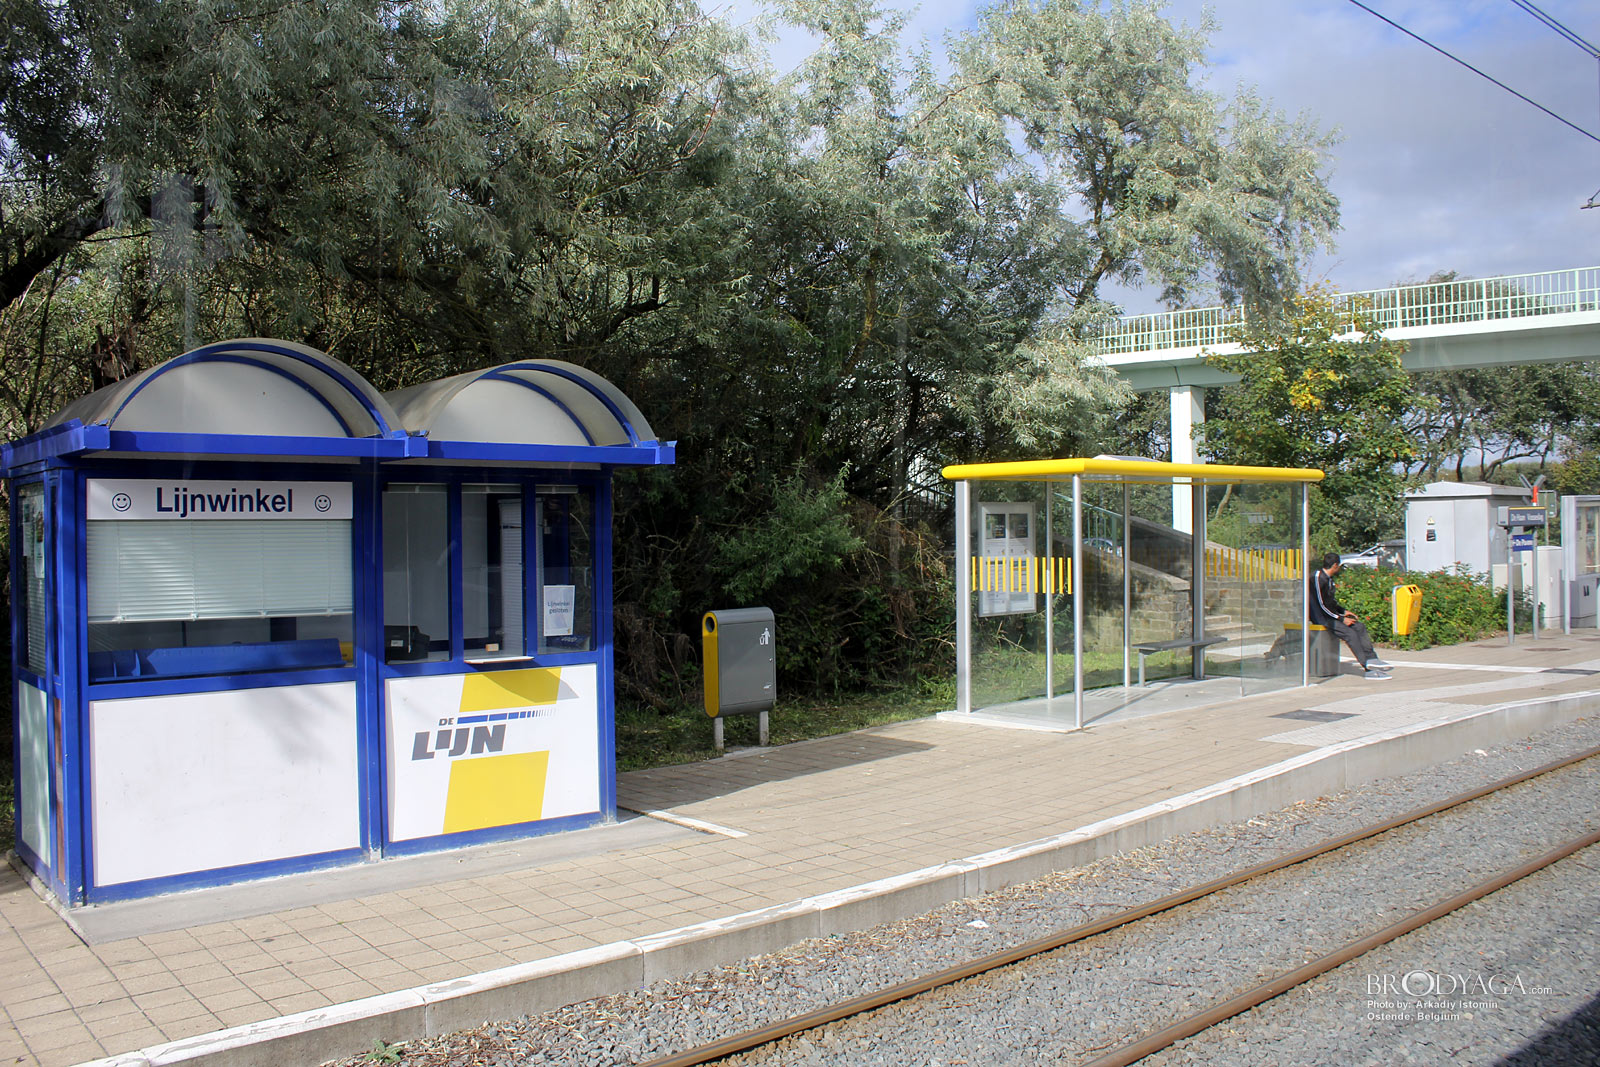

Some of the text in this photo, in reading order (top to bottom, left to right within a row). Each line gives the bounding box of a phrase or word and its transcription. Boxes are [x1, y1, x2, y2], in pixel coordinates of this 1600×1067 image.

[156, 487, 293, 518] Lijnwinkel
[438, 717, 454, 726] DE
[411, 723, 507, 761] LIJN
